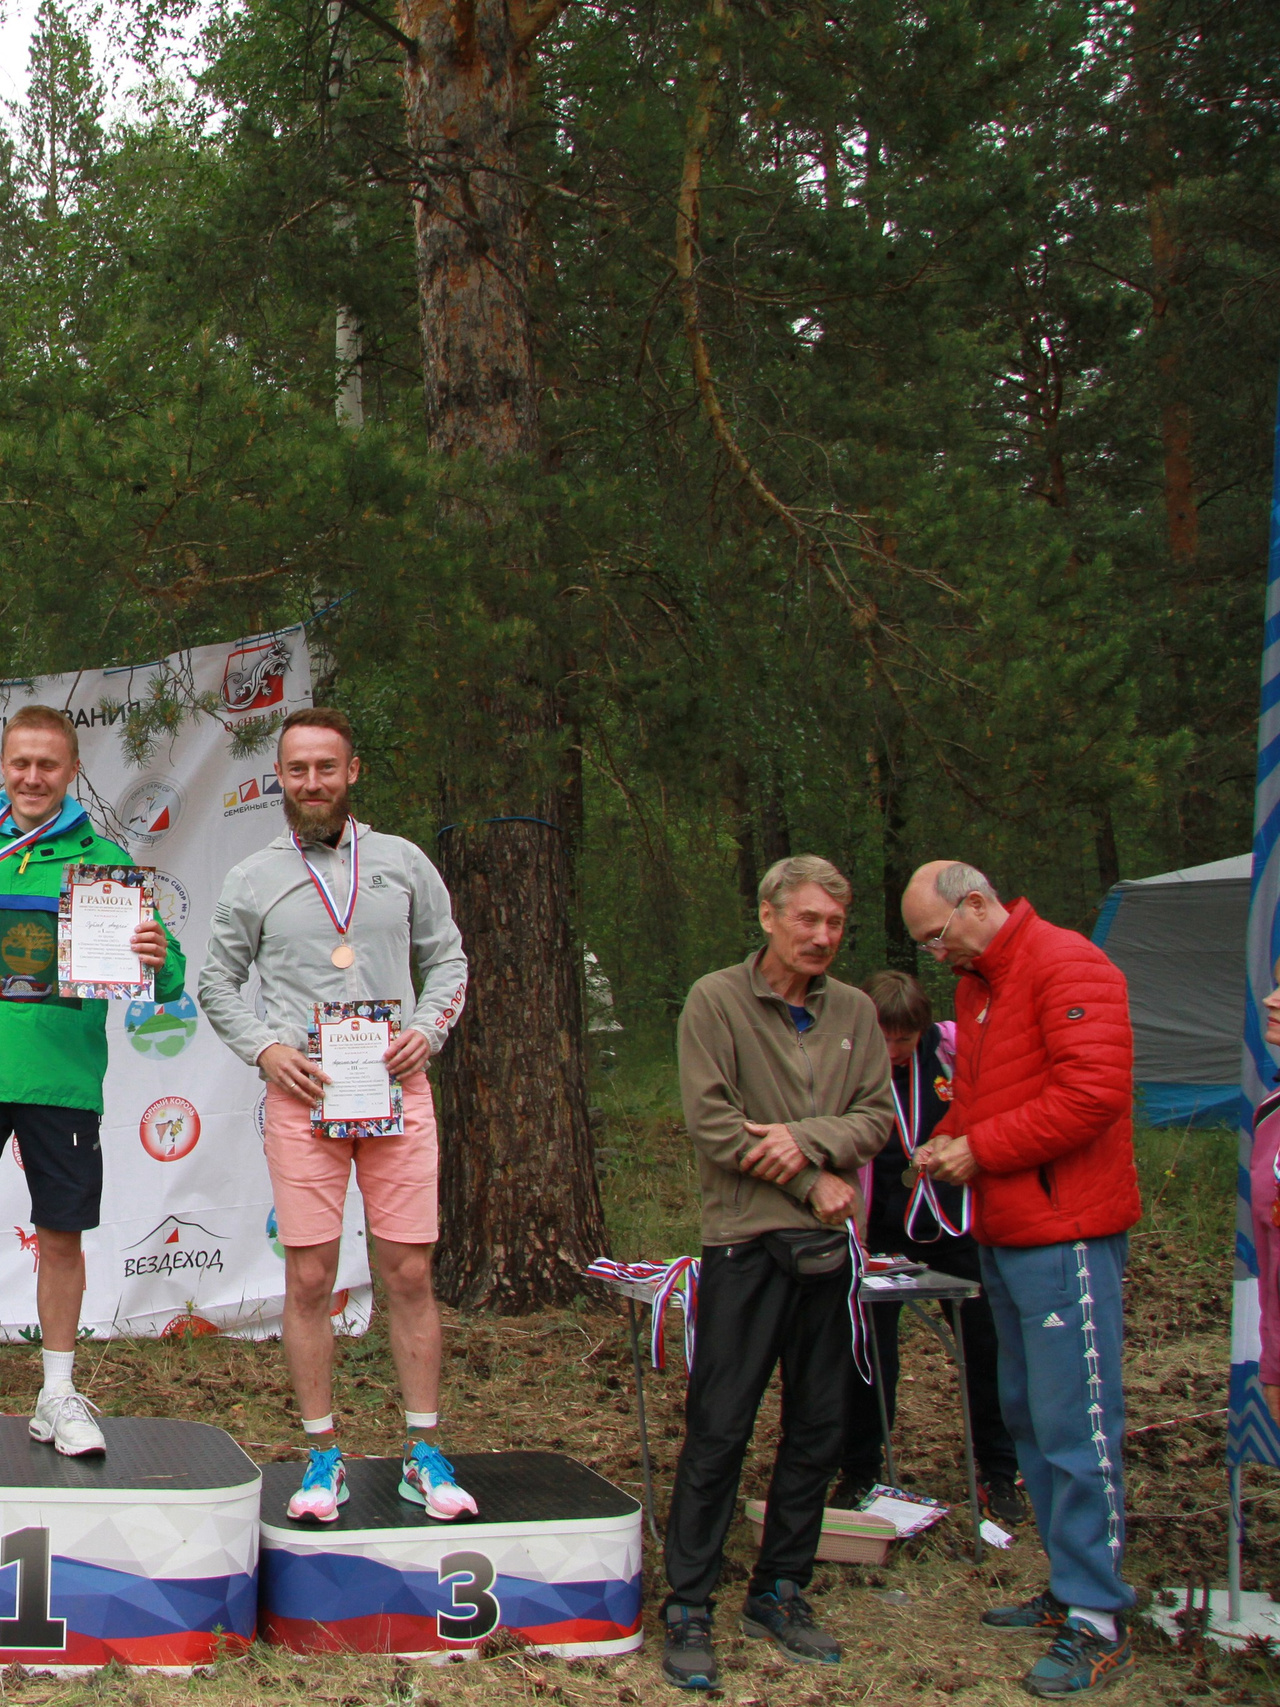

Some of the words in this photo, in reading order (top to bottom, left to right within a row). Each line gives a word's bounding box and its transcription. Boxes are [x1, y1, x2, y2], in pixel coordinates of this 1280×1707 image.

[223, 803, 268, 817] СЕМЕЙНЫЕ
[79, 895, 133, 906] ГРАМОТА
[329, 1033, 382, 1043] ГРАМОТА
[142, 1098, 169, 1124] ГОРНЫЙ
[169, 1098, 195, 1117] КОРОЛЬ
[123, 1249, 224, 1278] ВЕЗДЕХОД
[435, 1550, 500, 1642] 3
